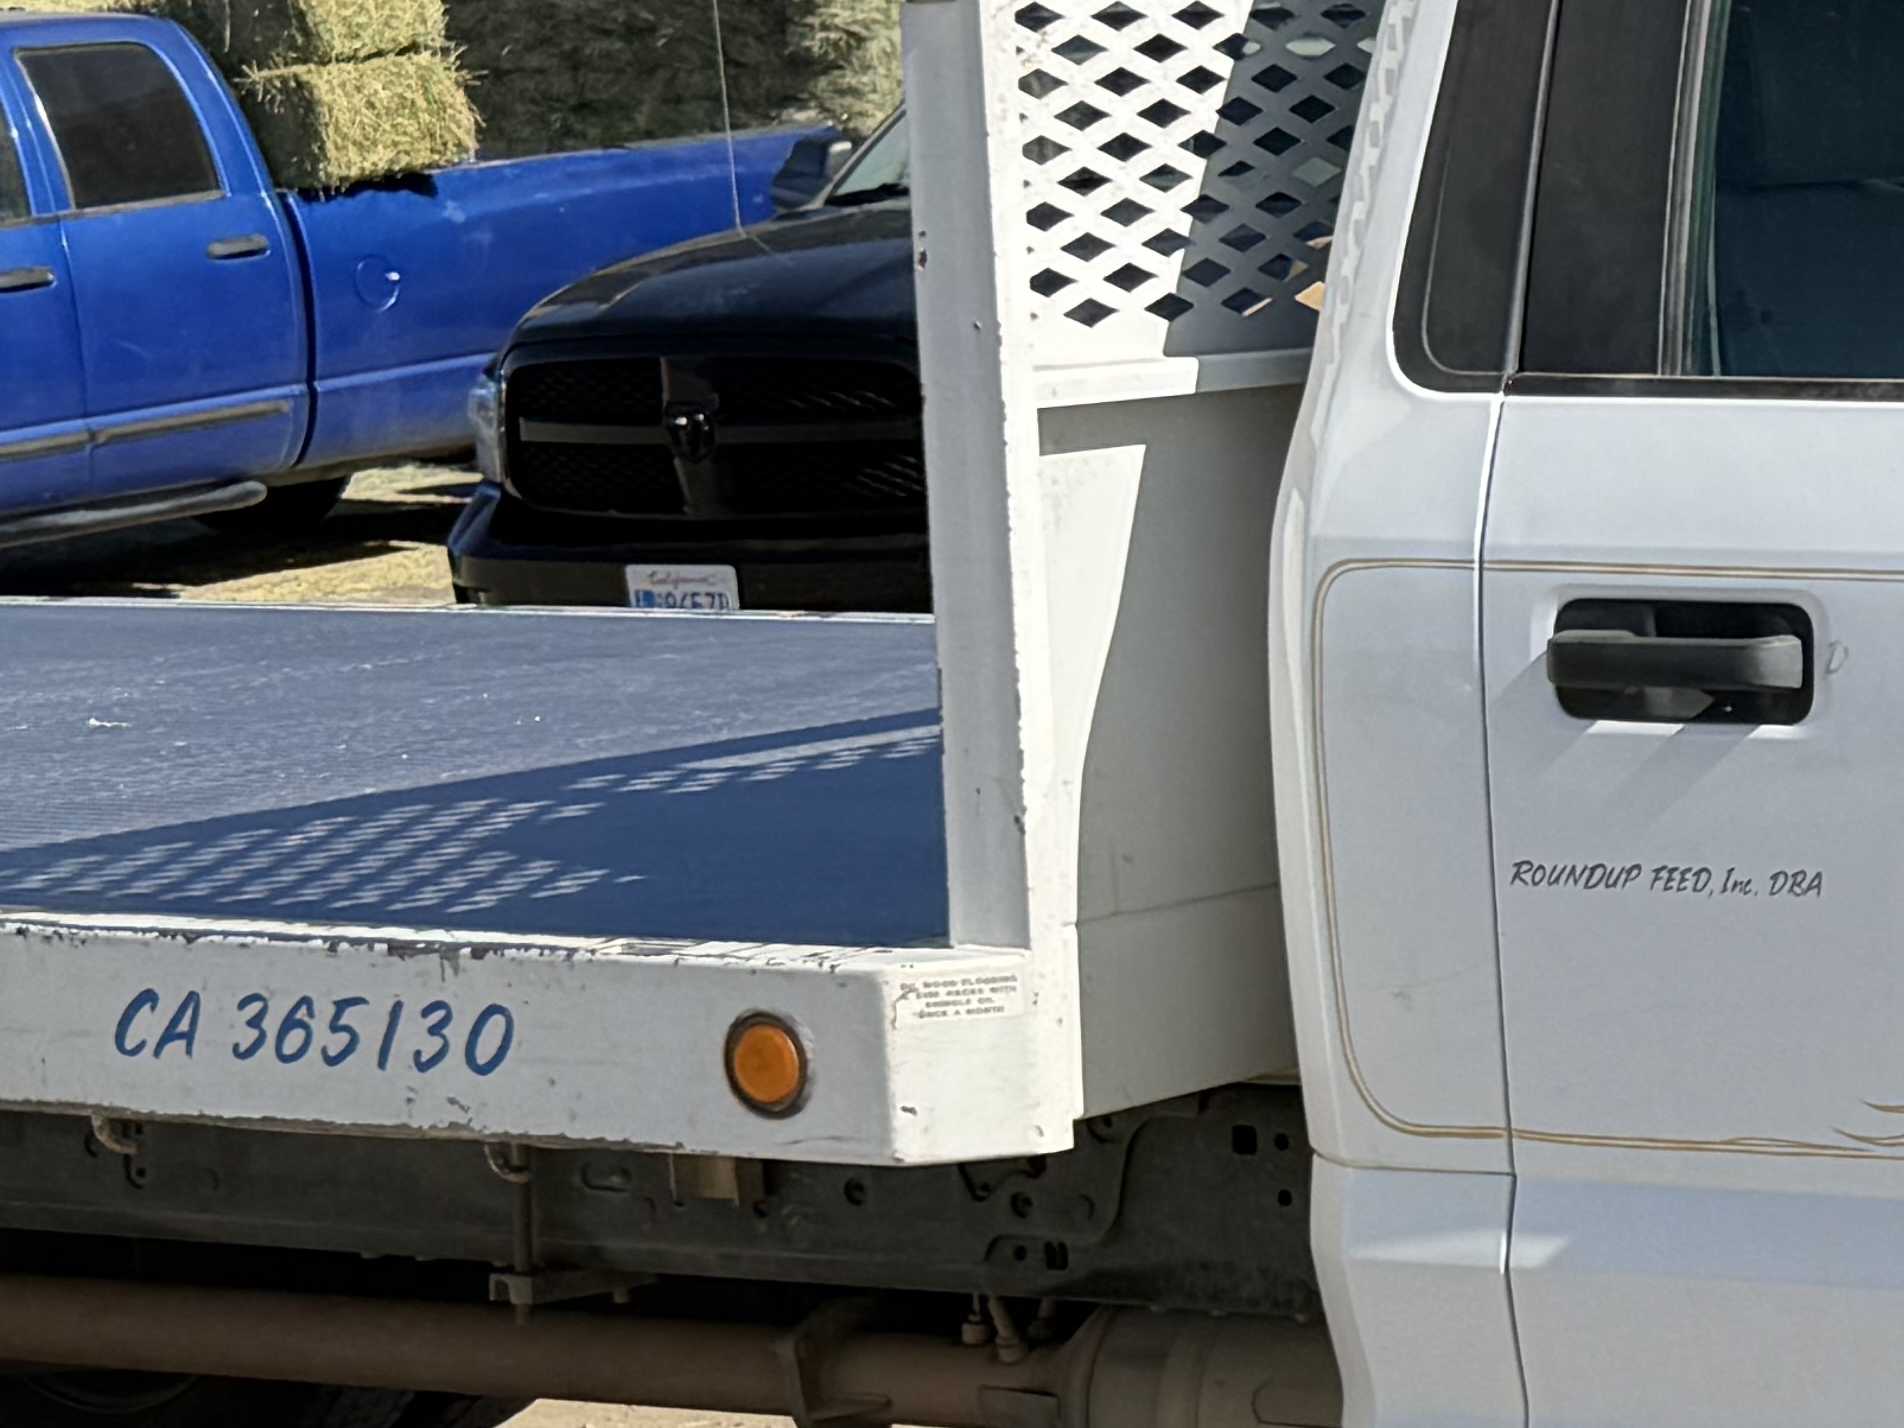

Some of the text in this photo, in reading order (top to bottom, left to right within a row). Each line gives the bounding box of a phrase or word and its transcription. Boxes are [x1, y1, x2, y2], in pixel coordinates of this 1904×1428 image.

[1510, 860, 1825, 899] ROUNDUP FEED, Inc. DBA
[114, 987, 515, 1076] CA 365130
